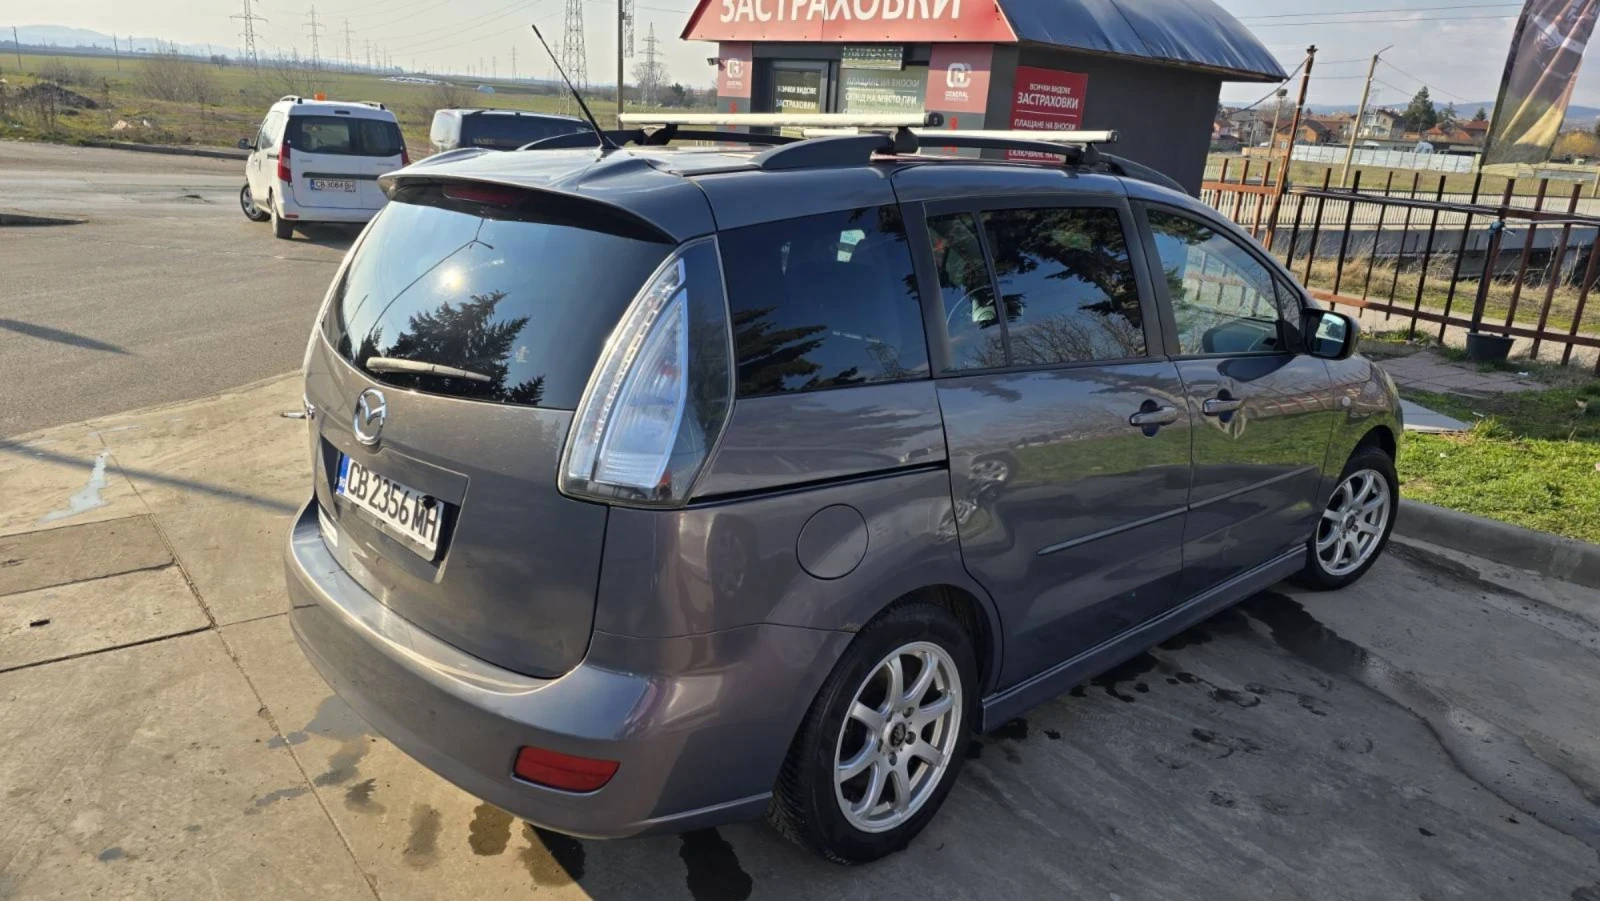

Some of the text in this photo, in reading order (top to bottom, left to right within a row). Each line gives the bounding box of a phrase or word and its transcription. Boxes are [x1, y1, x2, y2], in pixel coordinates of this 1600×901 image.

[719, 0, 961, 23] ЗАСТРАХОВКИ
[1029, 83, 1071, 95] ВСИЧКИ ВИДОВЕ
[775, 98, 816, 110] ЗАСТРАХОВКИ
[1017, 92, 1079, 110] ЗАСТРАХОВКИ
[1014, 118, 1076, 131] ПЛАЩАНЕ НА ВНОСКИ
[368, 474, 410, 526] 2356
